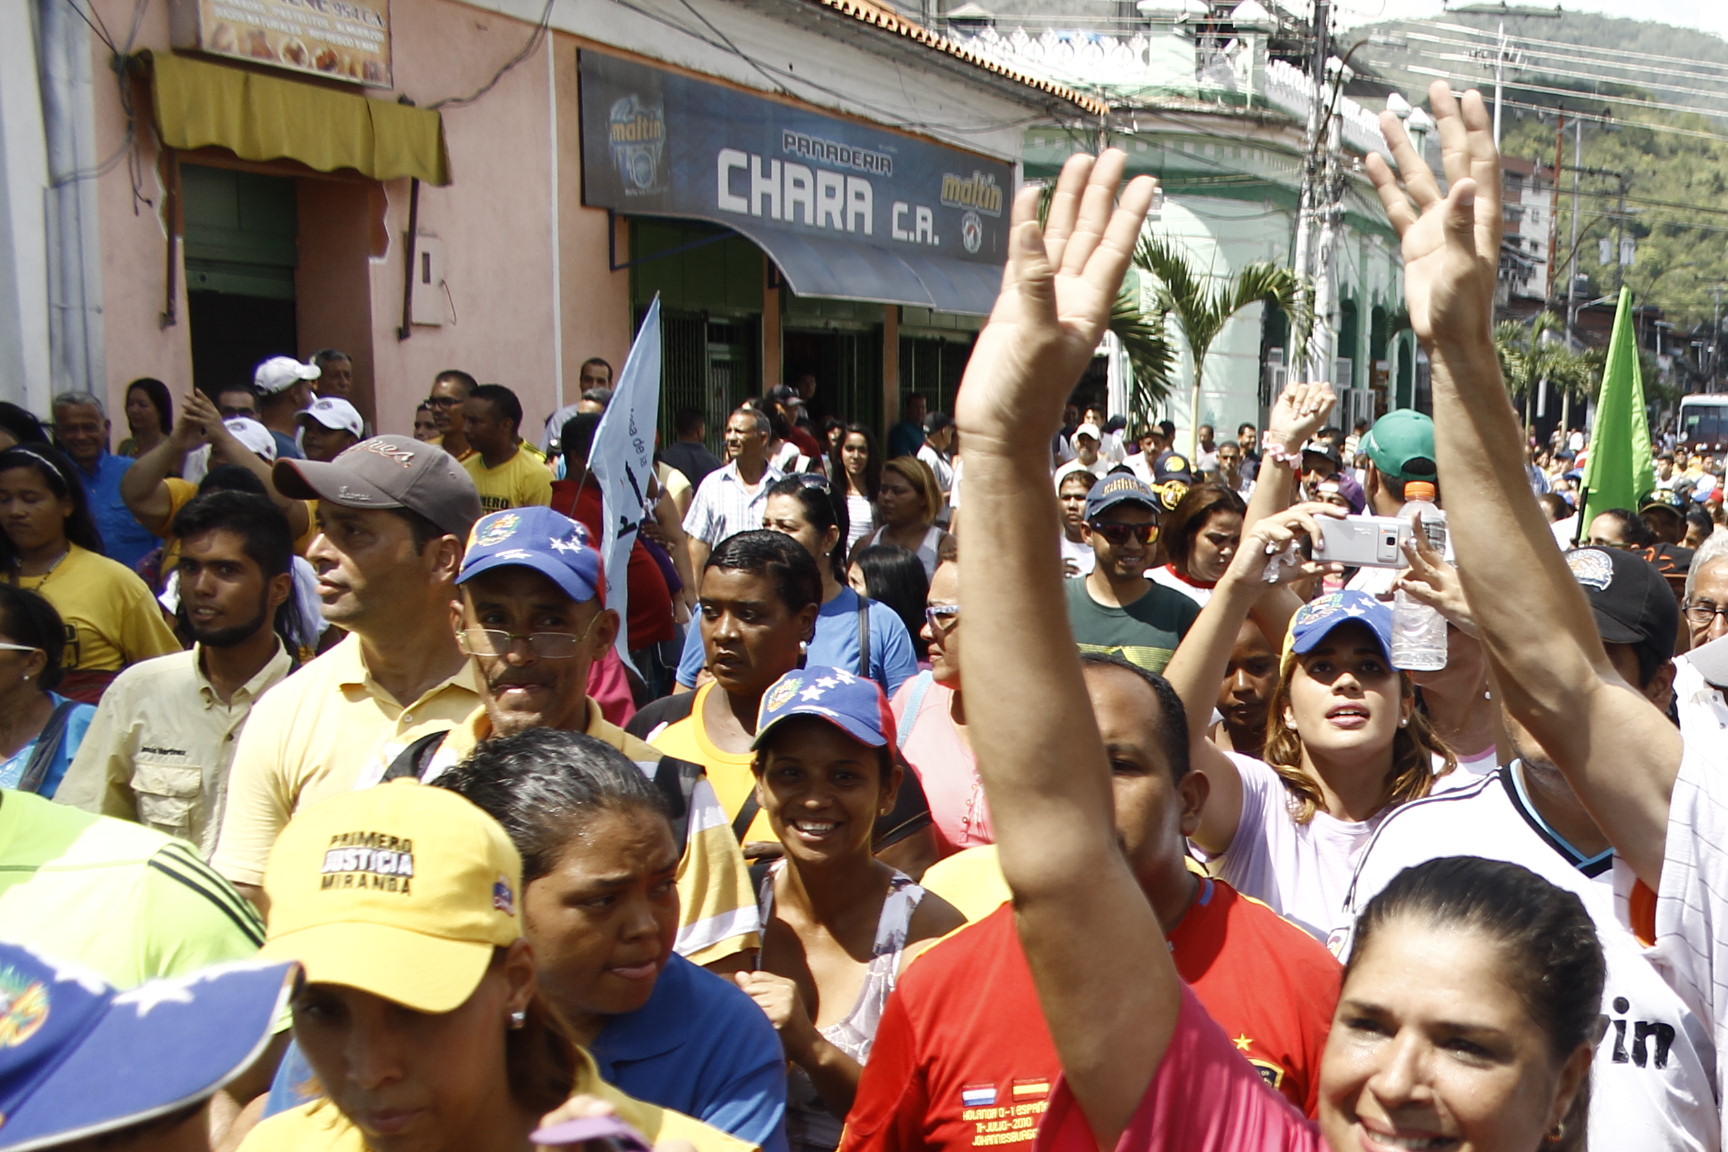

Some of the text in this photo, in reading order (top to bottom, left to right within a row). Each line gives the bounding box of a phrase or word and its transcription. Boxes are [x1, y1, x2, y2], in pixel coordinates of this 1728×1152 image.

[782, 129, 893, 177] PANADERIA
[717, 147, 941, 247] CHARA C.A.
[329, 831, 413, 852] PRIMERO
[321, 848, 414, 879] JUSTICIA
[320, 872, 412, 896] MIRANDA
[1601, 996, 1676, 1070] in
[962, 1108, 998, 1121] HOLANDA
